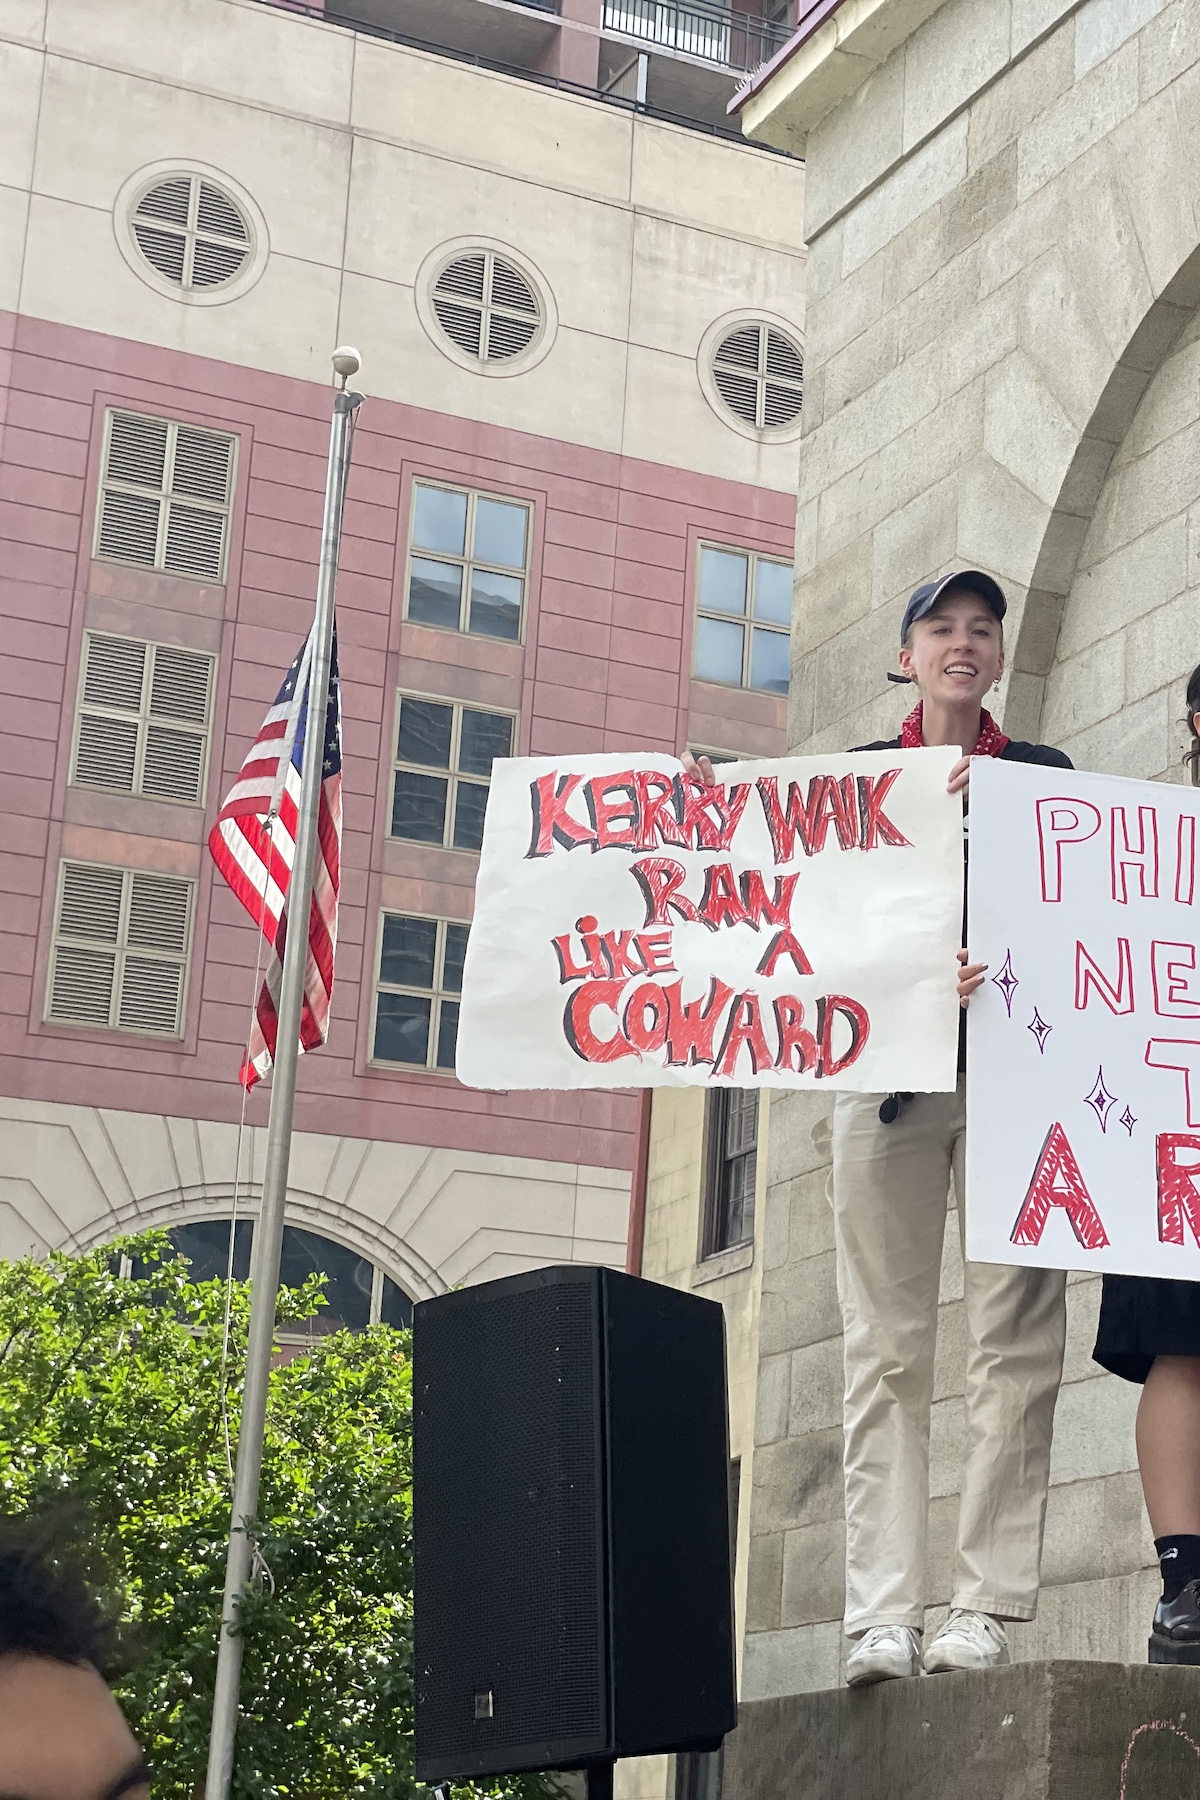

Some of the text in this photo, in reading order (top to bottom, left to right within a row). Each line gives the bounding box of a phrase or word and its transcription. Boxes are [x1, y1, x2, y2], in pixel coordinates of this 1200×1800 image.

[523, 769, 752, 859] KERRY
[629, 857, 801, 932] RAN
[755, 930, 816, 977] A
[563, 975, 872, 1079] COWARD
